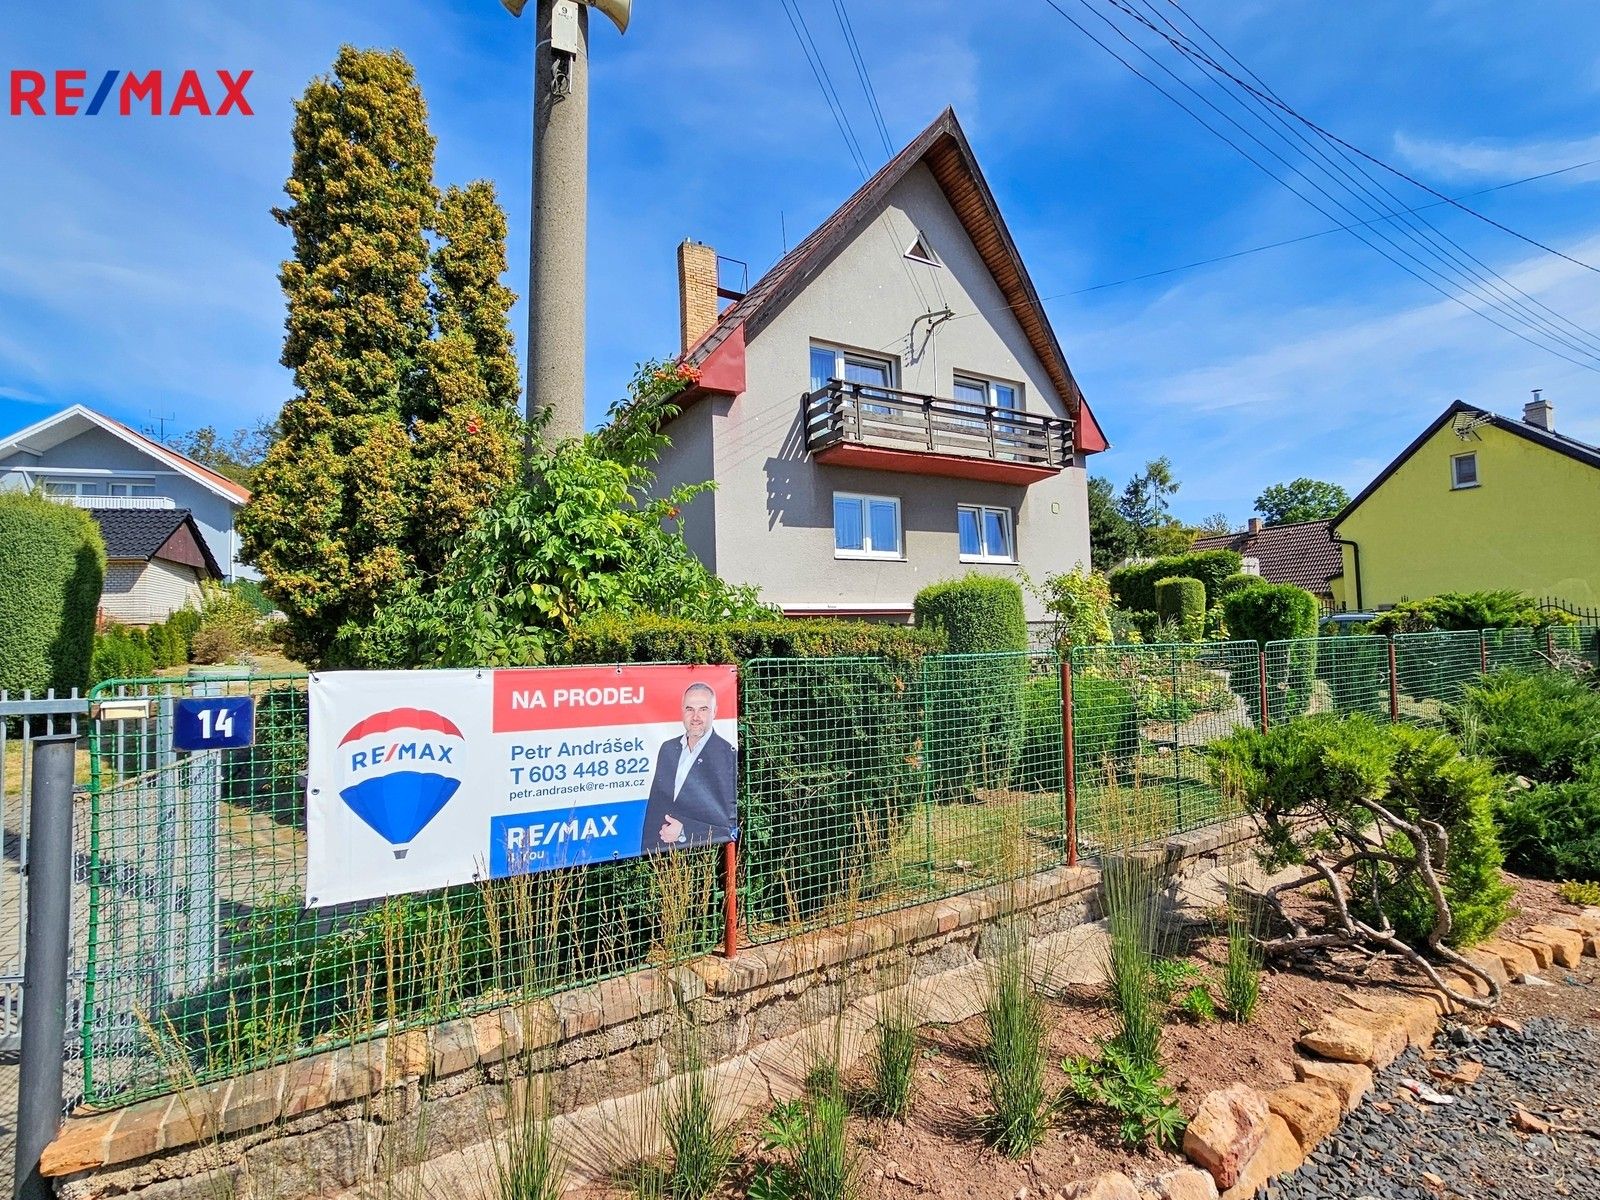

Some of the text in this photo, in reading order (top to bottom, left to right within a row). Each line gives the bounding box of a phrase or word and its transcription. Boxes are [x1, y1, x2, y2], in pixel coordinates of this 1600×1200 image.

[511, 686, 645, 710] NA PRODEJ
[197, 708, 233, 739] 14
[351, 742, 453, 772] RE/MAX
[511, 737, 644, 761] Petr Andrášek
[510, 757, 650, 785] T 603 448 822
[509, 779, 646, 802] petr.andrasek@re-max.cz
[507, 815, 619, 850] RE/MAX
